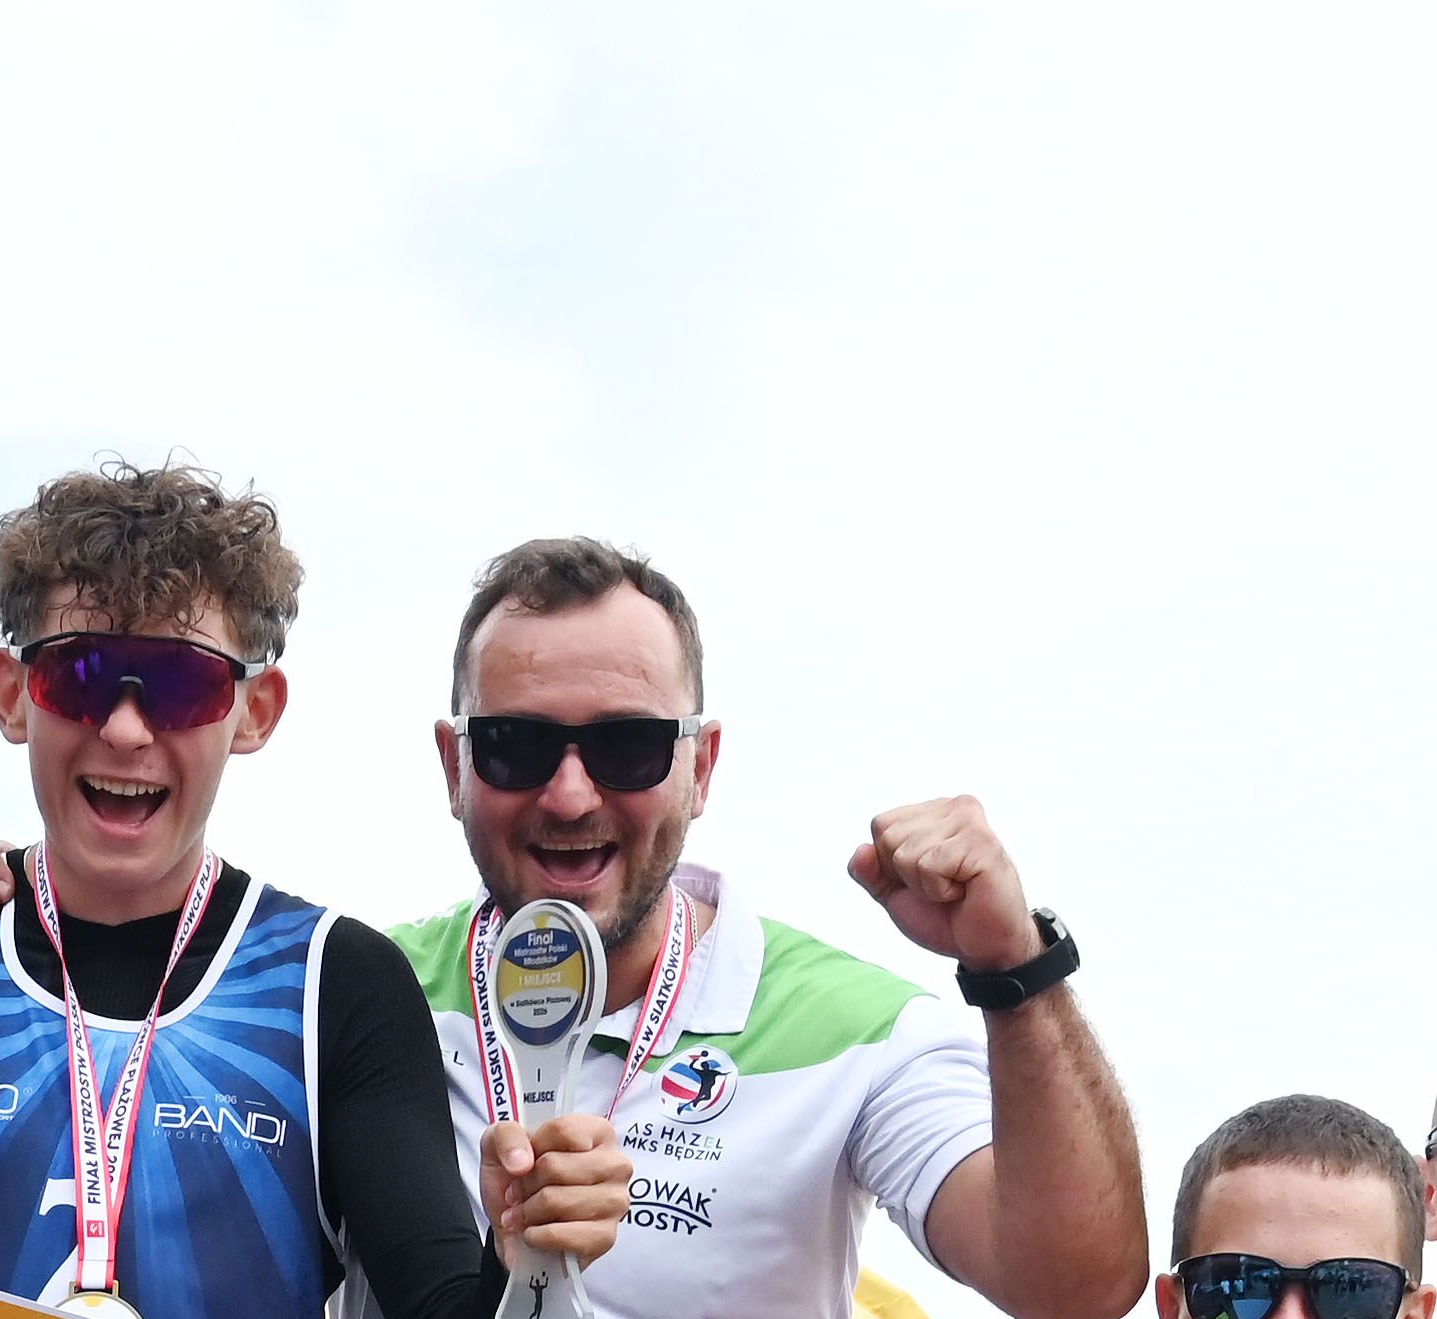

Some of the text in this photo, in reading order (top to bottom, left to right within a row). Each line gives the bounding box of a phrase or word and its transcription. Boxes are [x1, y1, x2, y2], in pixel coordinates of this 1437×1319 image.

[527, 931, 554, 947] Final
[649, 936, 682, 1024] SIATKÓWCE
[523, 1090, 556, 1104] MIEJSCE
[75, 1056, 102, 1205] FINAŁ MISTRZOSTW
[153, 1103, 287, 1147] BANDI
[624, 1135, 722, 1161] MKS BĘDZIN
[628, 1178, 712, 1219] OWAK
